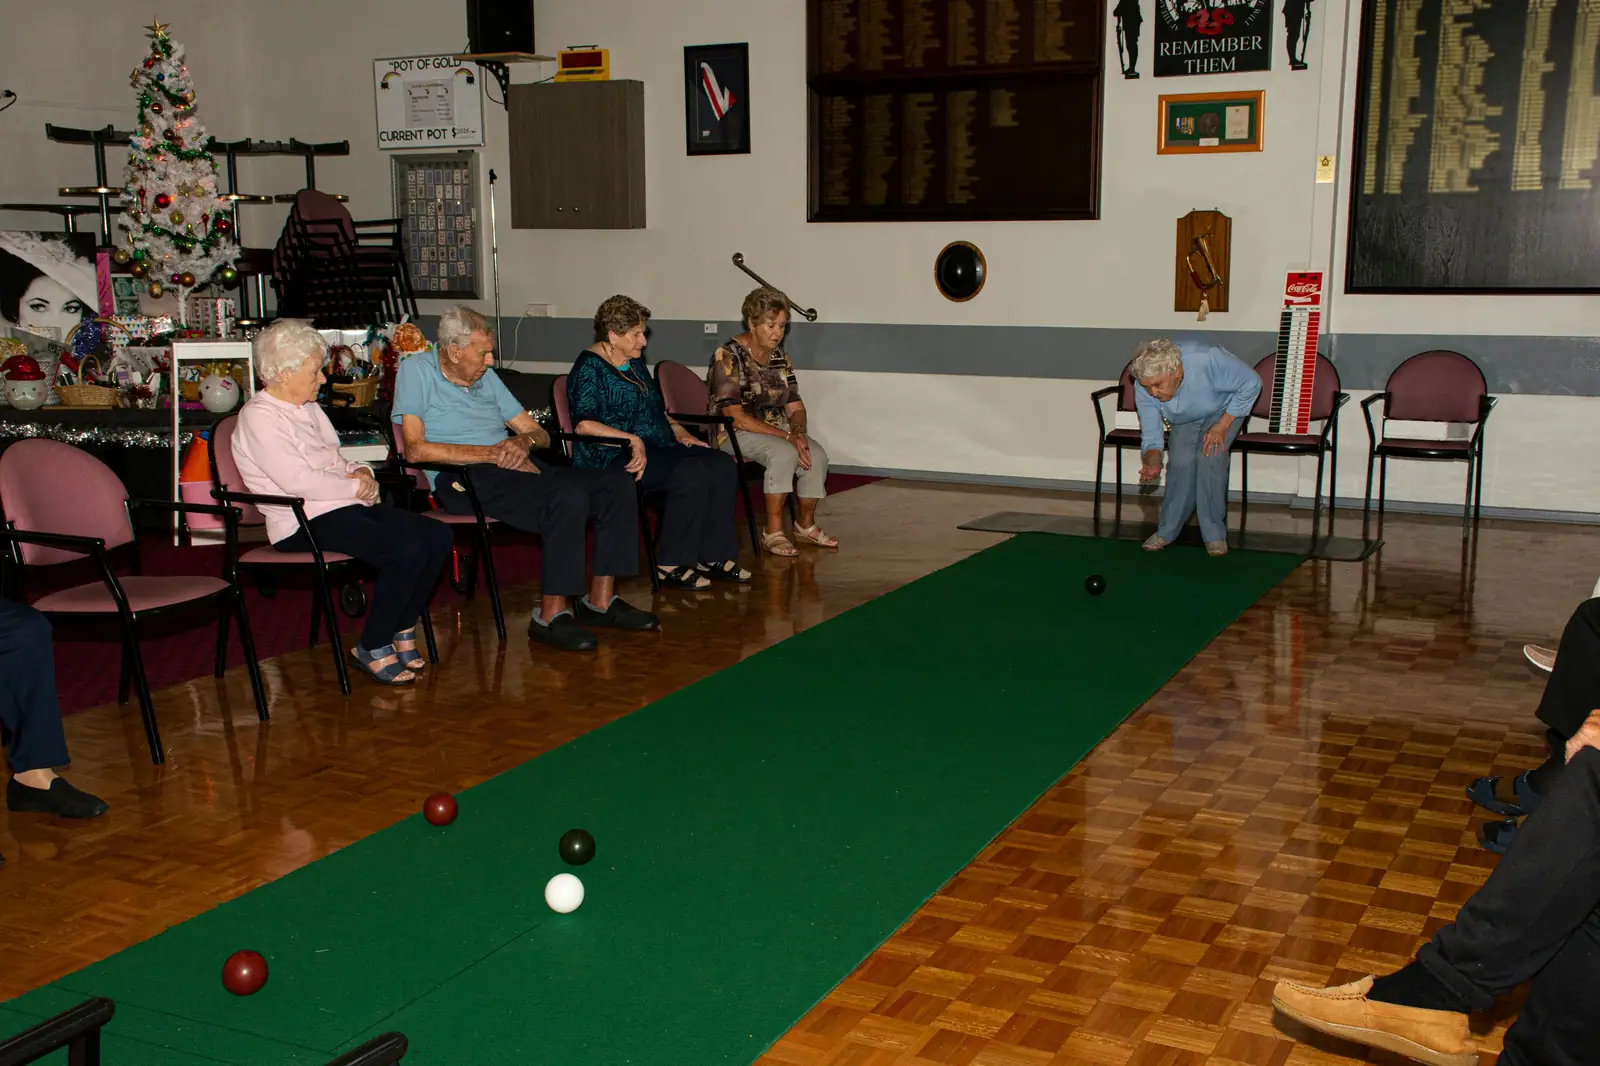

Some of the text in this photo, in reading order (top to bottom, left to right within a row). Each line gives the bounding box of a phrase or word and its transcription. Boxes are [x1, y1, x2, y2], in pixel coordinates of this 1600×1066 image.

[1160, 36, 1263, 56] REMEMBER
[417, 58, 432, 70] OF
[1184, 57, 1236, 74] THEM
[380, 129, 424, 142] CURRENT
[427, 128, 448, 140] POT
